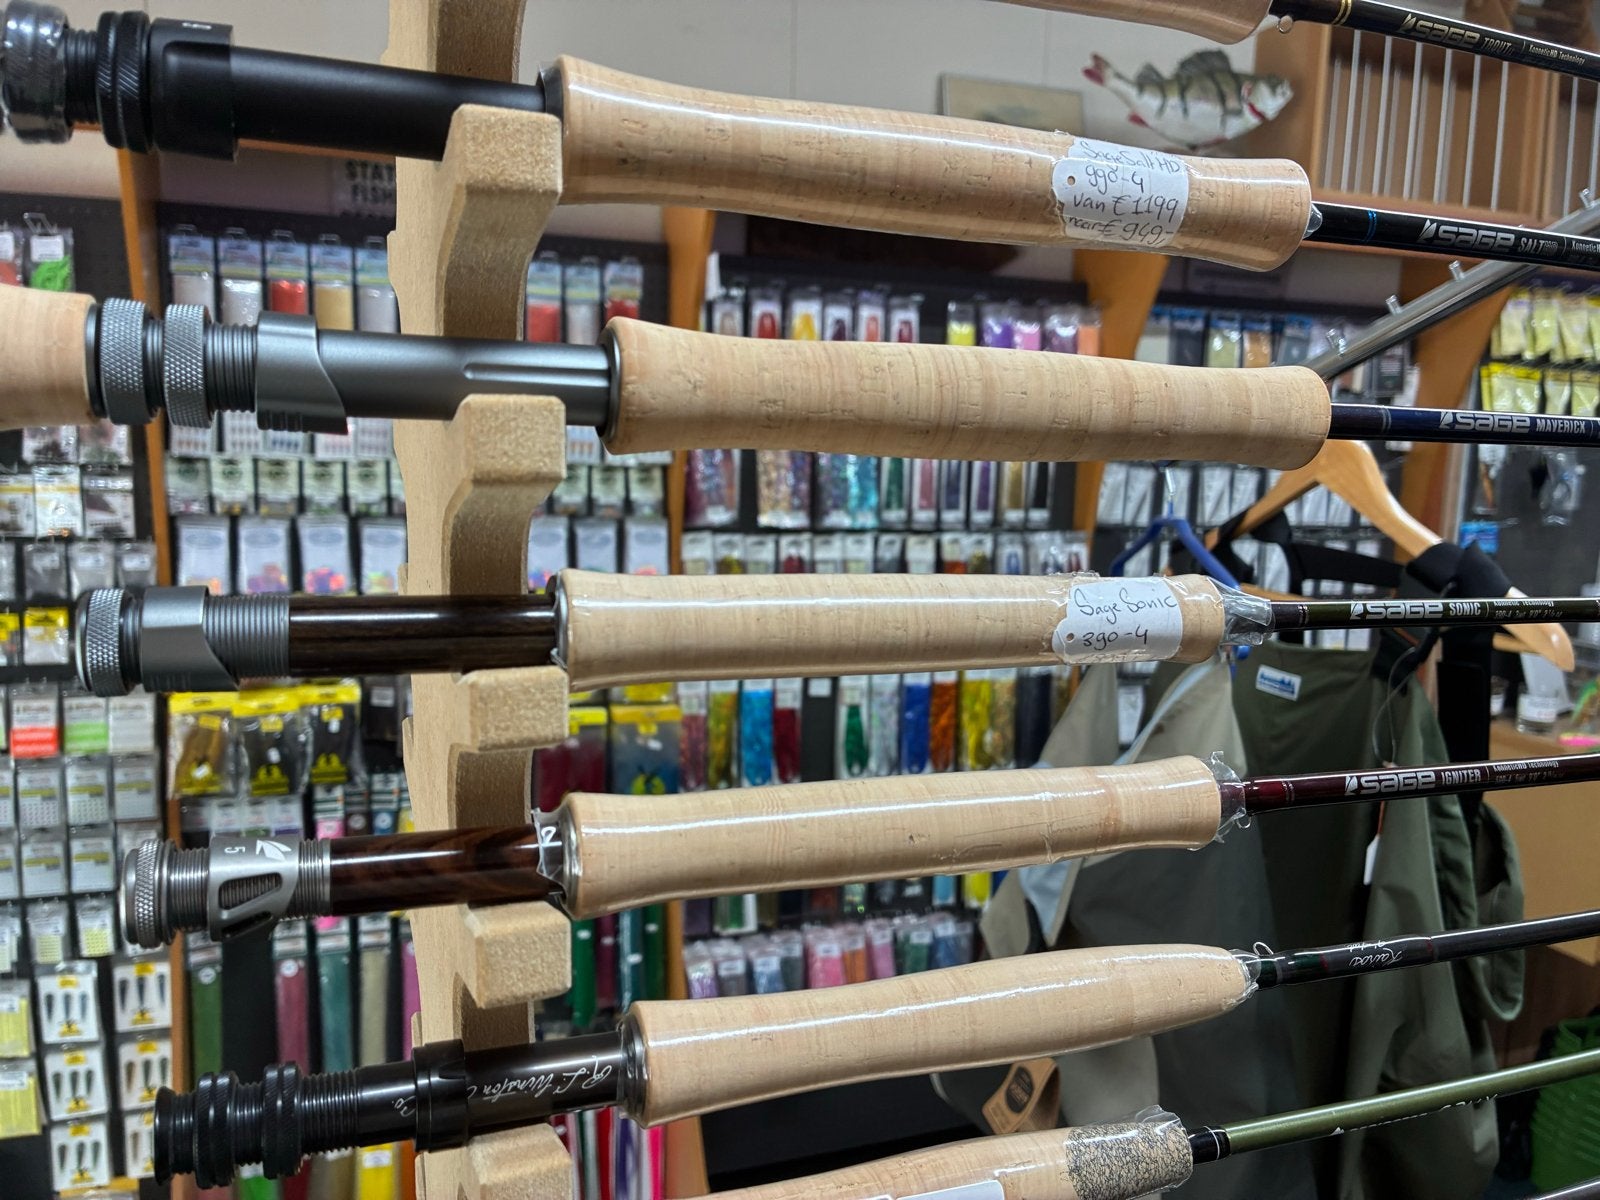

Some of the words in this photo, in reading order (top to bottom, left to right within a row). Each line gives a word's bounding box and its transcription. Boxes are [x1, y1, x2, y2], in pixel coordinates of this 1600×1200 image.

[1482, 37, 1512, 55] TROUT
[1073, 193, 1106, 213] van
[1535, 418, 1586, 434] MAVERICK
[1073, 588, 1121, 625] Sage
[1119, 587, 1178, 613] Sonic
[1449, 602, 1481, 617] SONIC
[1441, 768, 1481, 786] IGNITER
[224, 846, 246, 854] 5
[482, 1072, 554, 1103] Winston
